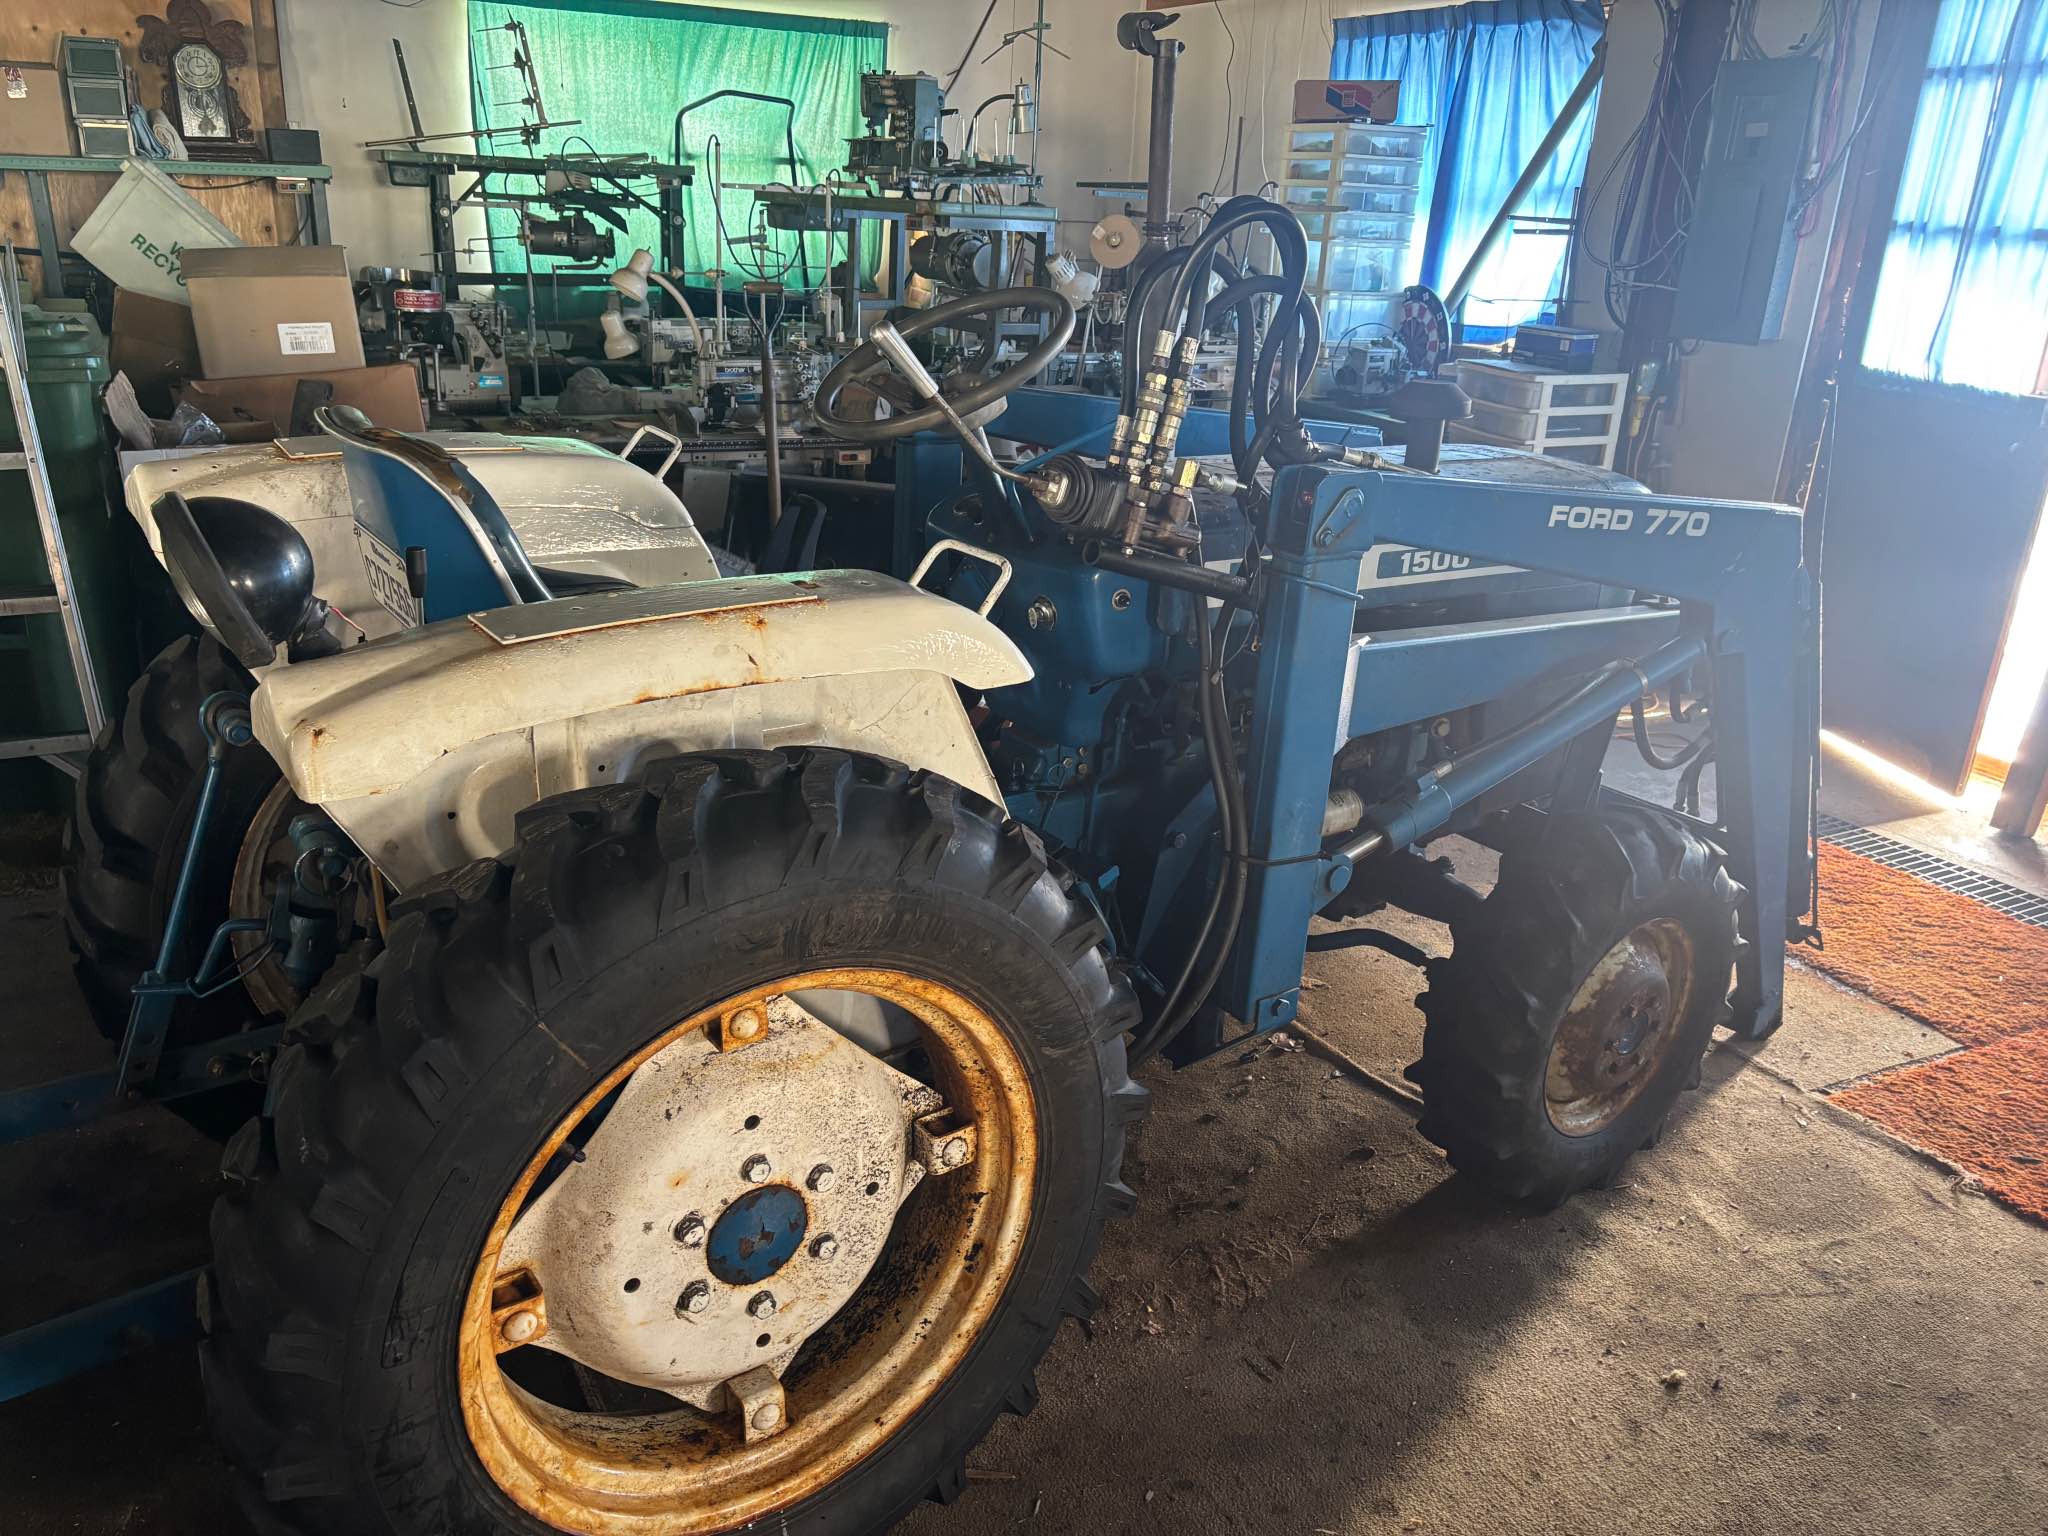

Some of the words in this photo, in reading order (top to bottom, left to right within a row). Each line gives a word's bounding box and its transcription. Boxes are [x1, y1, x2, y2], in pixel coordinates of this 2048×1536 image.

[1548, 505, 1634, 531] FORD
[1645, 508, 1711, 537] 770
[1400, 550, 1471, 574] 1500
